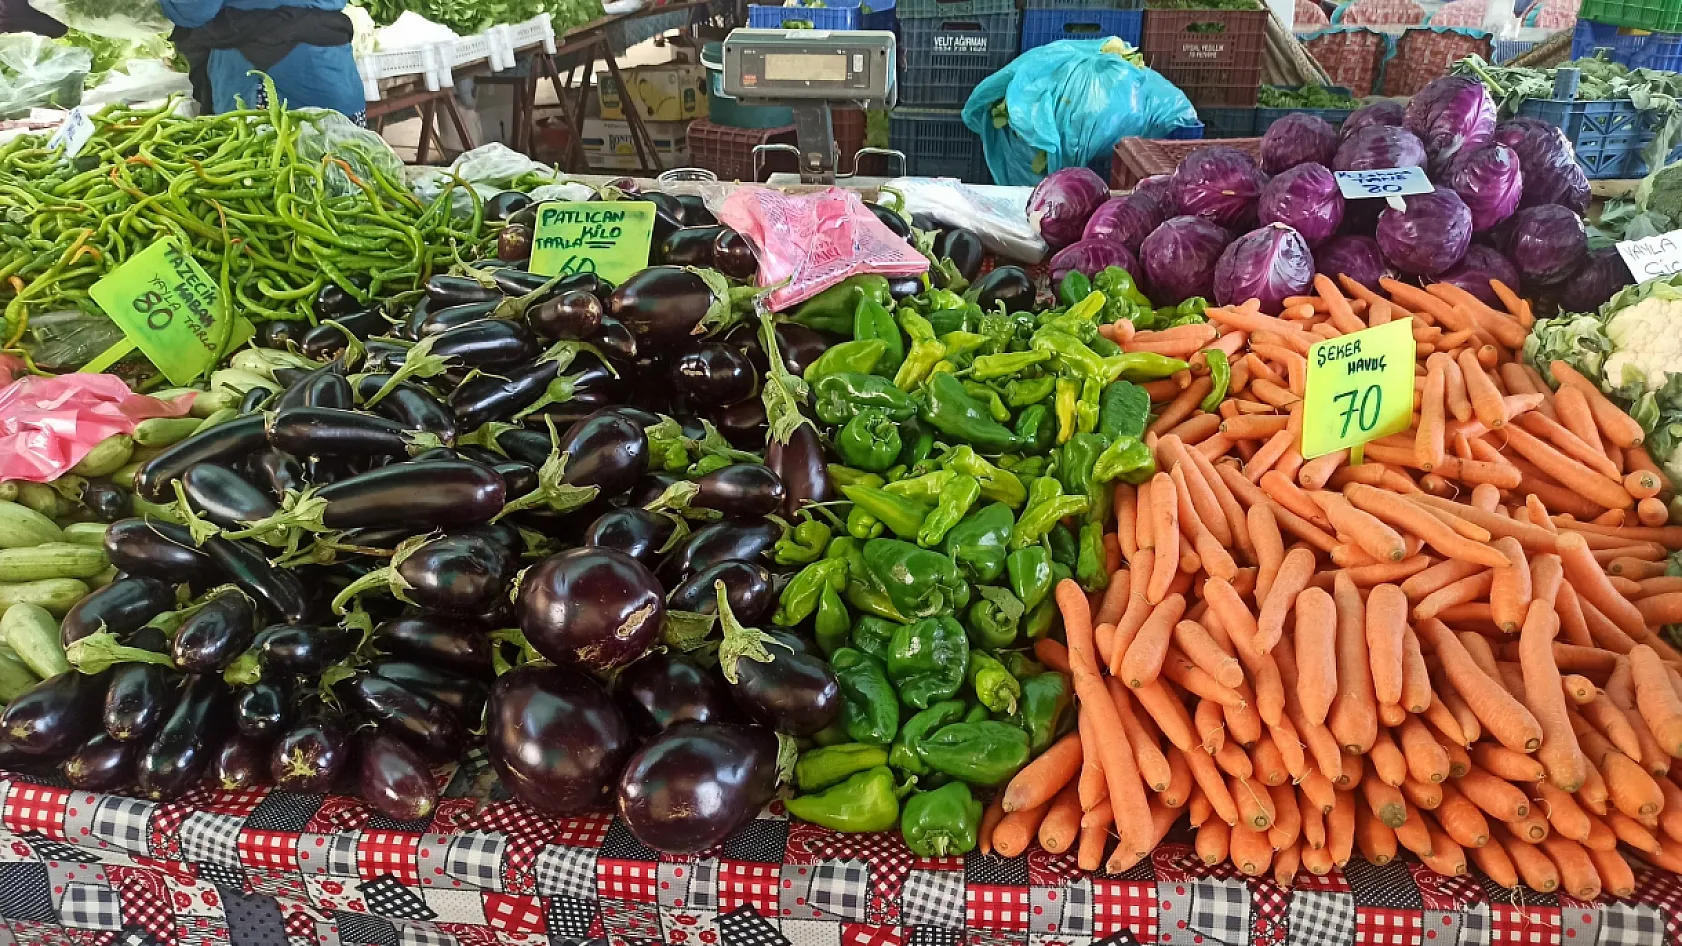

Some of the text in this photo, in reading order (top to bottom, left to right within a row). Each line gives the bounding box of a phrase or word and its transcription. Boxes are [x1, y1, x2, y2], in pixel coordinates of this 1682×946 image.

[542, 207, 626, 226] PATLICAN
[535, 237, 583, 250] TARLA
[132, 290, 174, 331] 80
[1317, 338, 1362, 368] ŞEKER
[1332, 384, 1383, 439] 70
